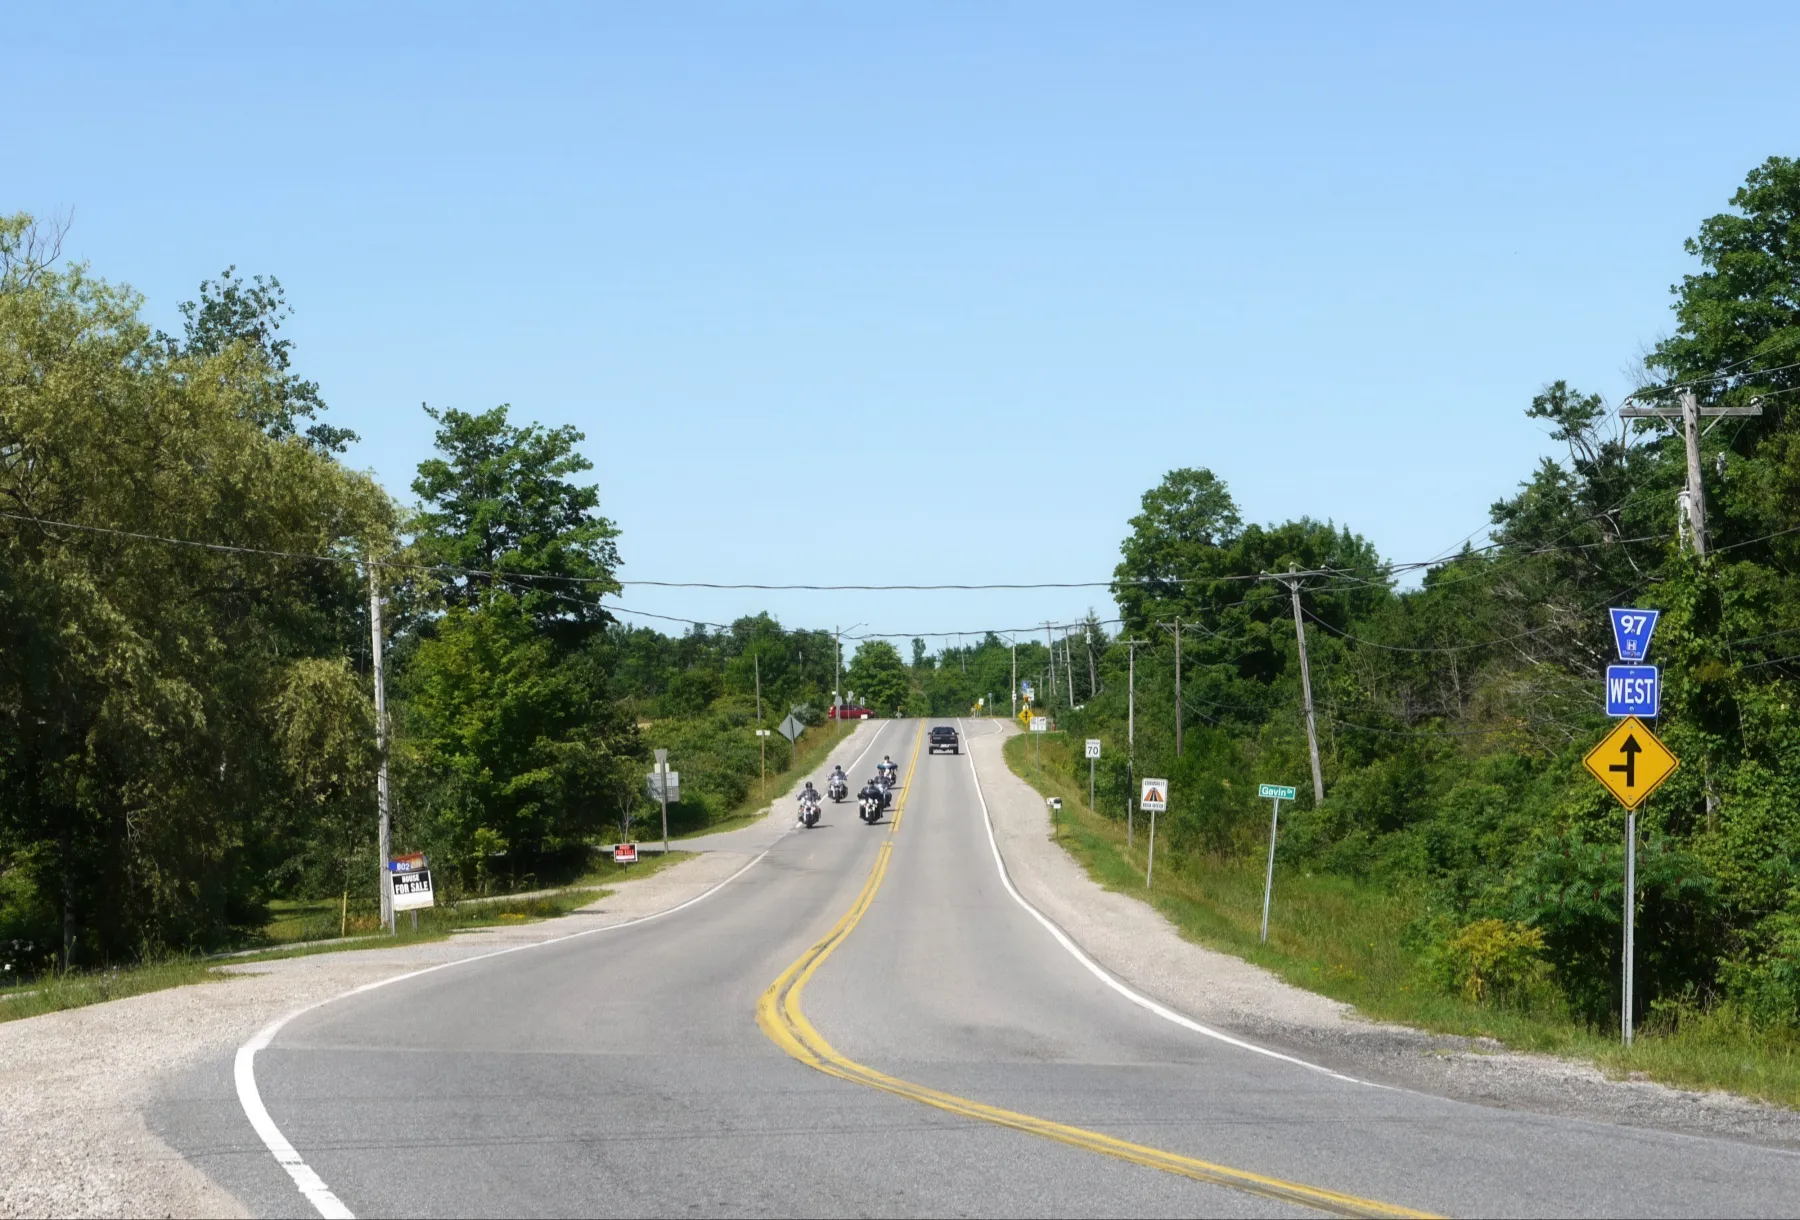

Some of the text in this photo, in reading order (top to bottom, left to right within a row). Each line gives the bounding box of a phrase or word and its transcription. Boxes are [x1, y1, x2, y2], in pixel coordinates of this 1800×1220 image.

[1621, 615, 1647, 635] 97
[1610, 678, 1654, 704] WEST
[1087, 745, 1099, 755] 70
[1261, 786, 1286, 797] Gavin
[396, 862, 410, 871] 802
[401, 874, 420, 883] HOUSE
[395, 880, 429, 895] FOR SALE
